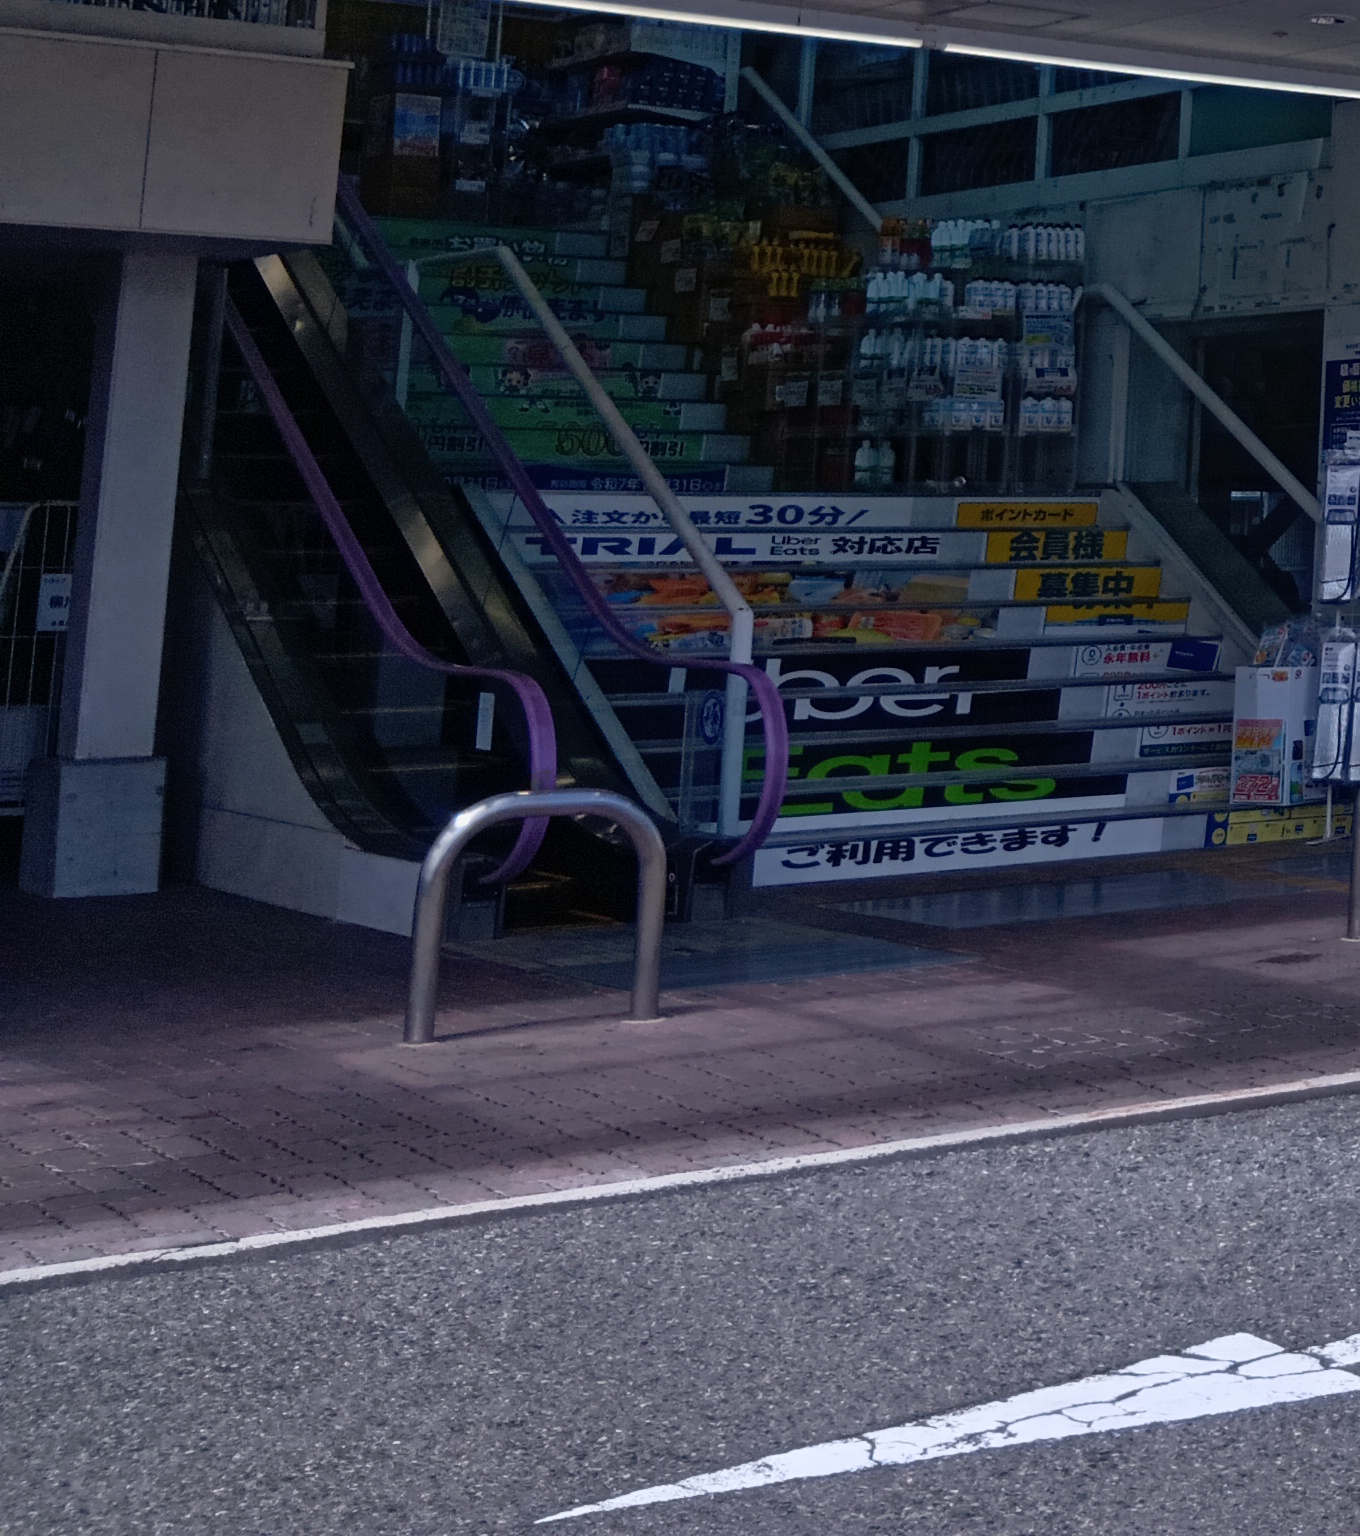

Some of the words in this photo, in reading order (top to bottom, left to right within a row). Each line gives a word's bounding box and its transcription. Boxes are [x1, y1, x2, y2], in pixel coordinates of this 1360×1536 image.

[980, 508, 1075, 522] ポイントカード
[771, 534, 822, 546] Uber
[832, 535, 940, 556] 対応店
[1008, 530, 1104, 561] 会員様
[770, 547, 821, 556] Eats
[1037, 569, 1134, 598] 募集中
